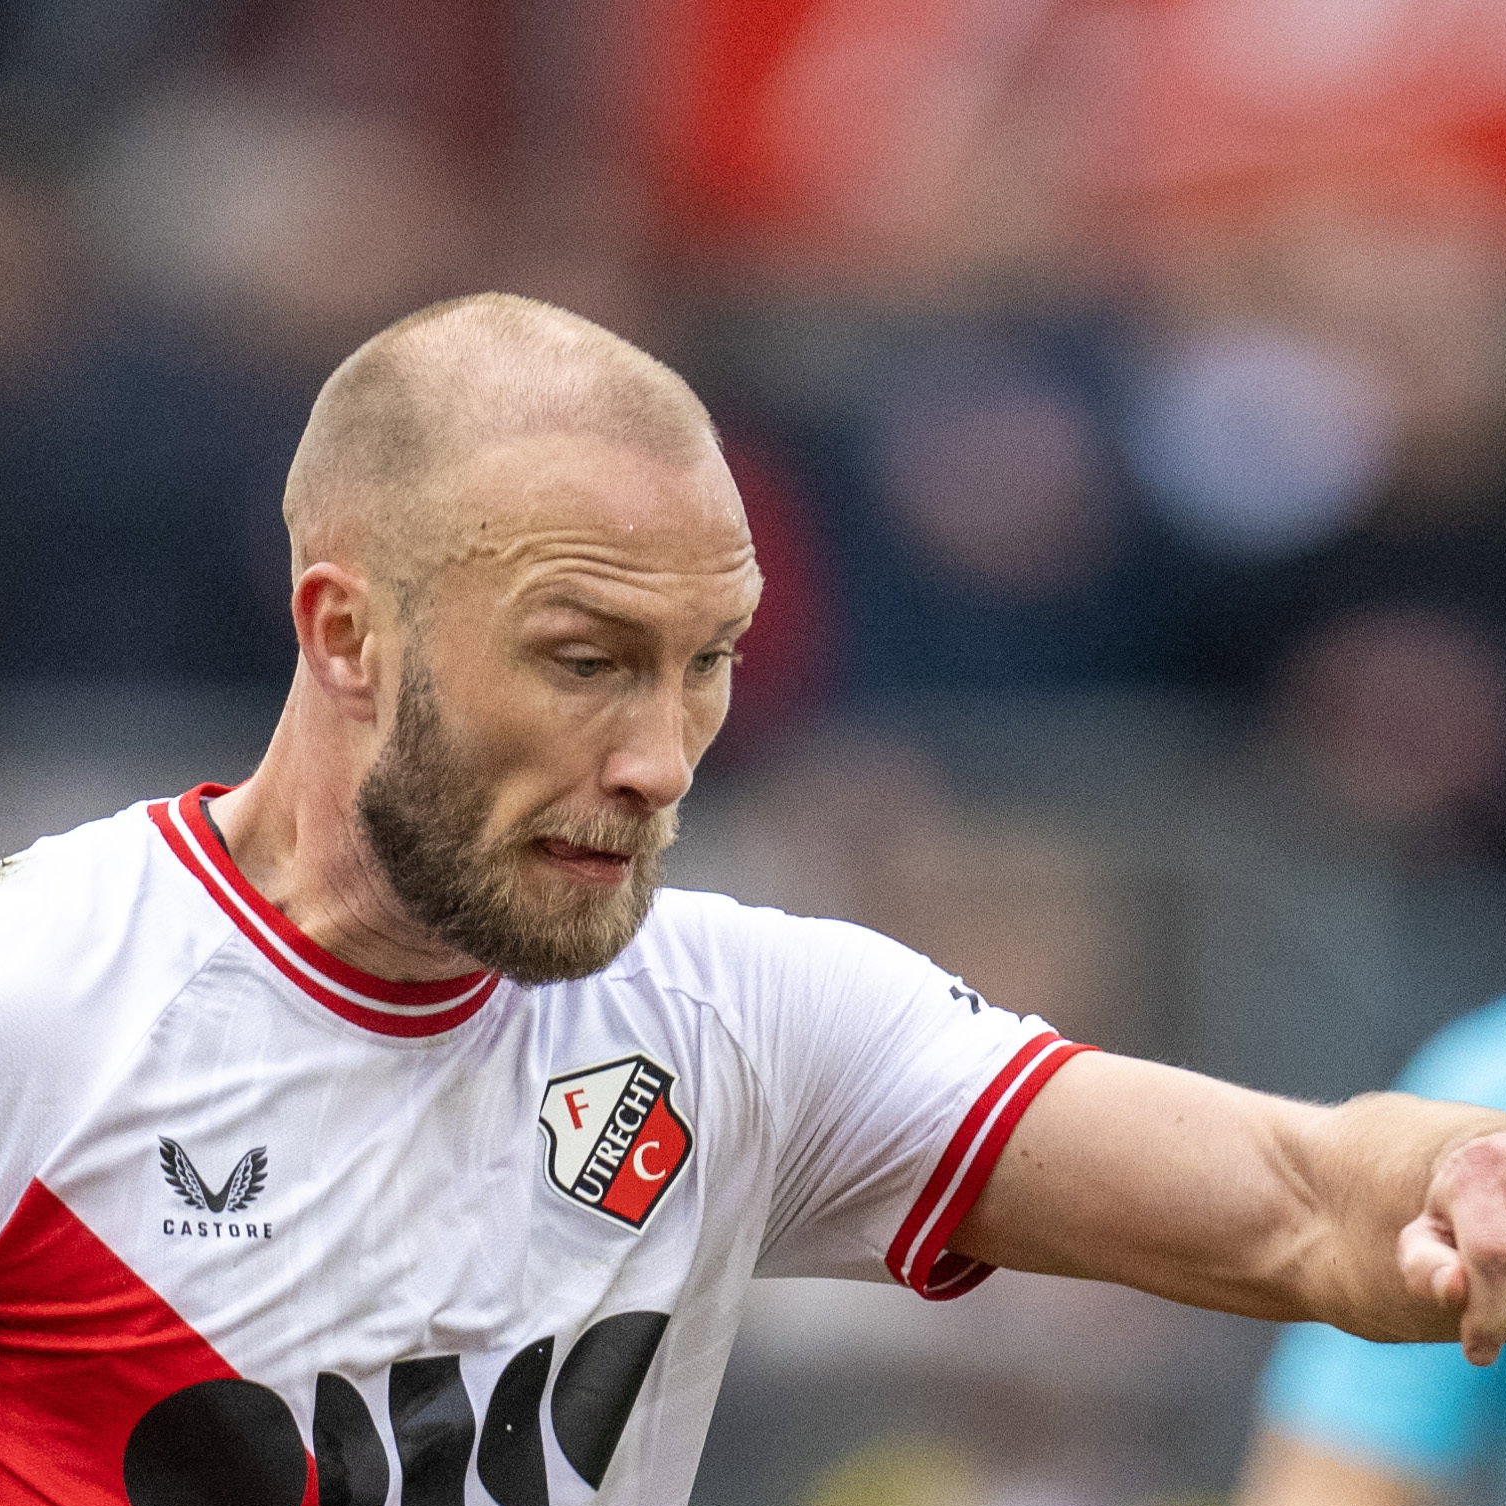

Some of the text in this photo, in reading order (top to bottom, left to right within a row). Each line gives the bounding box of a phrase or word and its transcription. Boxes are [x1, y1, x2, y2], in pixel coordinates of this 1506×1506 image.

[564, 1087, 590, 1131] F
[574, 1064, 662, 1204] UTRECHT
[632, 1139, 667, 1182] C
[162, 1218, 273, 1240] CASTORE
